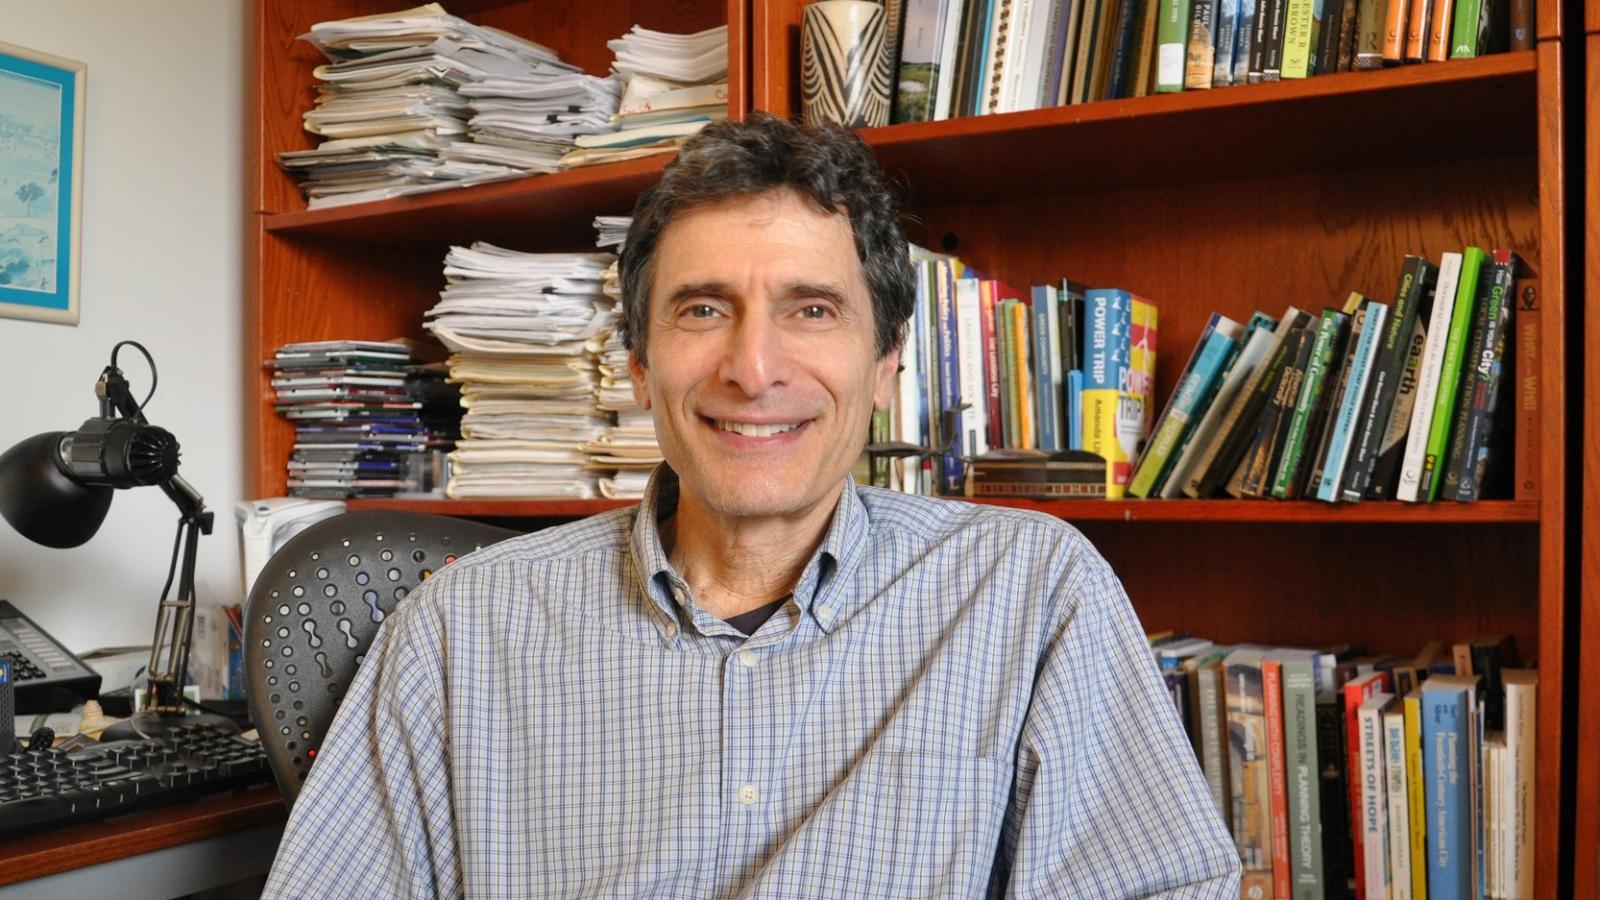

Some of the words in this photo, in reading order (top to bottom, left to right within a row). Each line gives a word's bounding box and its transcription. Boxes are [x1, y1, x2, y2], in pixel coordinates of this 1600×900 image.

[1193, 4, 1202, 40] GILDING
[1201, 3, 1210, 25] PAUL
[1289, 3, 1300, 45] BROWN
[1299, 1, 1310, 37] ESTER
[1399, 272, 1413, 298] Cities
[1487, 285, 1503, 320] Green
[1093, 296, 1105, 348] POWER
[1394, 298, 1407, 317] and
[1314, 330, 1328, 356] Power
[1385, 317, 1401, 349] Nature
[1523, 323, 1536, 357] WHAT
[1039, 336, 1048, 375] COMMUNITY
[1093, 351, 1104, 384] TRIP
[1312, 356, 1320, 366] of
[1399, 335, 1424, 395] eaarth
[1476, 348, 1493, 380] City?
[1297, 366, 1317, 412] Community
[1523, 375, 1536, 409] WHAT
[1093, 399, 1101, 438] Amanda
[1266, 671, 1278, 716] PLANNING
[1294, 694, 1307, 750] READINGS
[1298, 752, 1306, 763] IN
[1364, 717, 1375, 769] STREETS
[1446, 732, 1457, 769] Planning
[1297, 765, 1310, 821] PLANNING
[1367, 773, 1375, 790] OF
[1448, 770, 1457, 784] the
[1366, 794, 1377, 832] HOPE
[1437, 809, 1447, 848] American
[1299, 824, 1312, 868] THEORY
[1436, 850, 1448, 867] City
